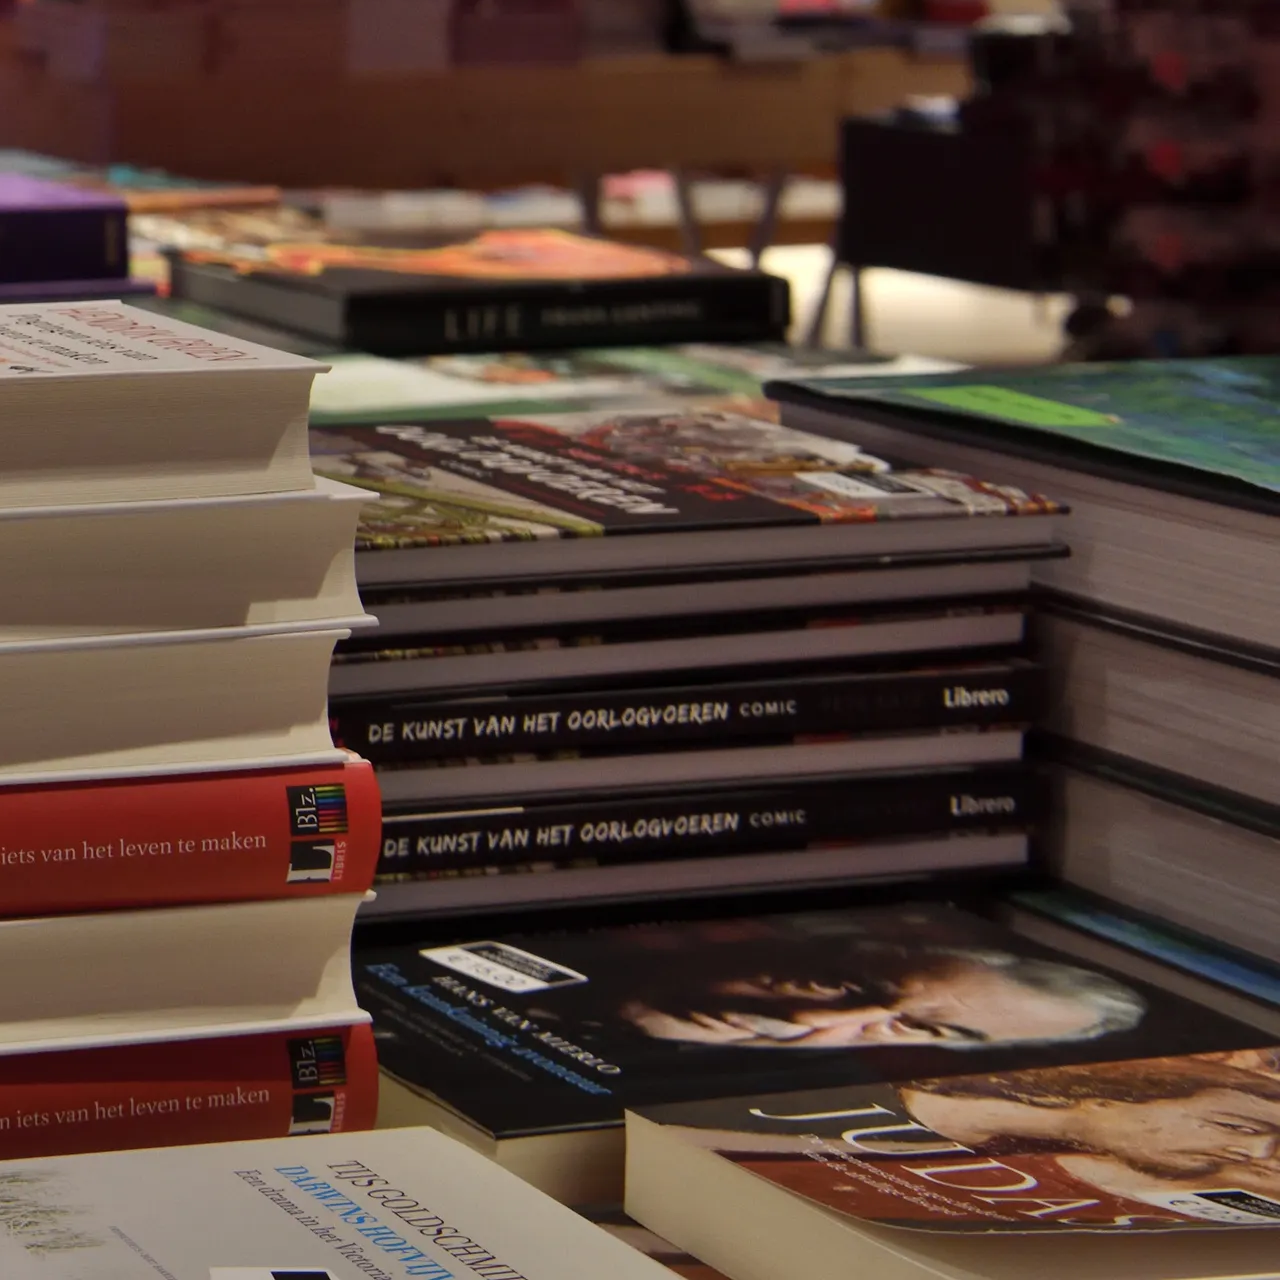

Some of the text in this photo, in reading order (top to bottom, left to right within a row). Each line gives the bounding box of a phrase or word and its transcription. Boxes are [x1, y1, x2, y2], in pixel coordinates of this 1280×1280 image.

[943, 685, 1010, 708] Librero
[368, 723, 394, 743] DE
[402, 718, 467, 741] KUNST
[474, 716, 515, 737] VAN
[523, 712, 560, 734] HET
[568, 701, 729, 731] OORLOGVOEREN
[739, 699, 798, 717] COMIC
[950, 795, 1016, 817] Librero
[1, 845, 36, 864] iets
[41, 845, 77, 863] van
[82, 840, 115, 860] het
[119, 837, 172, 858] leven
[178, 838, 197, 854] te
[201, 831, 267, 852] maken
[384, 809, 807, 859] DE KUNST VAN HET OORLOGVOEREN COMIC
[333, 840, 346, 881] LIBRIS
[16, 1109, 50, 1129] iets
[54, 1108, 90, 1125] van
[94, 1101, 124, 1120] het
[129, 1097, 180, 1116] leven
[185, 1095, 203, 1112] te
[207, 1087, 270, 1109] maken
[327, 1160, 390, 1188] TIJS
[749, 1102, 1185, 1227] JUDAS
[233, 1169, 268, 1188] Een
[258, 1187, 306, 1217] drama
[295, 1216, 320, 1228] in
[308, 1226, 343, 1244] het
[273, 1165, 378, 1225] DARWINS
